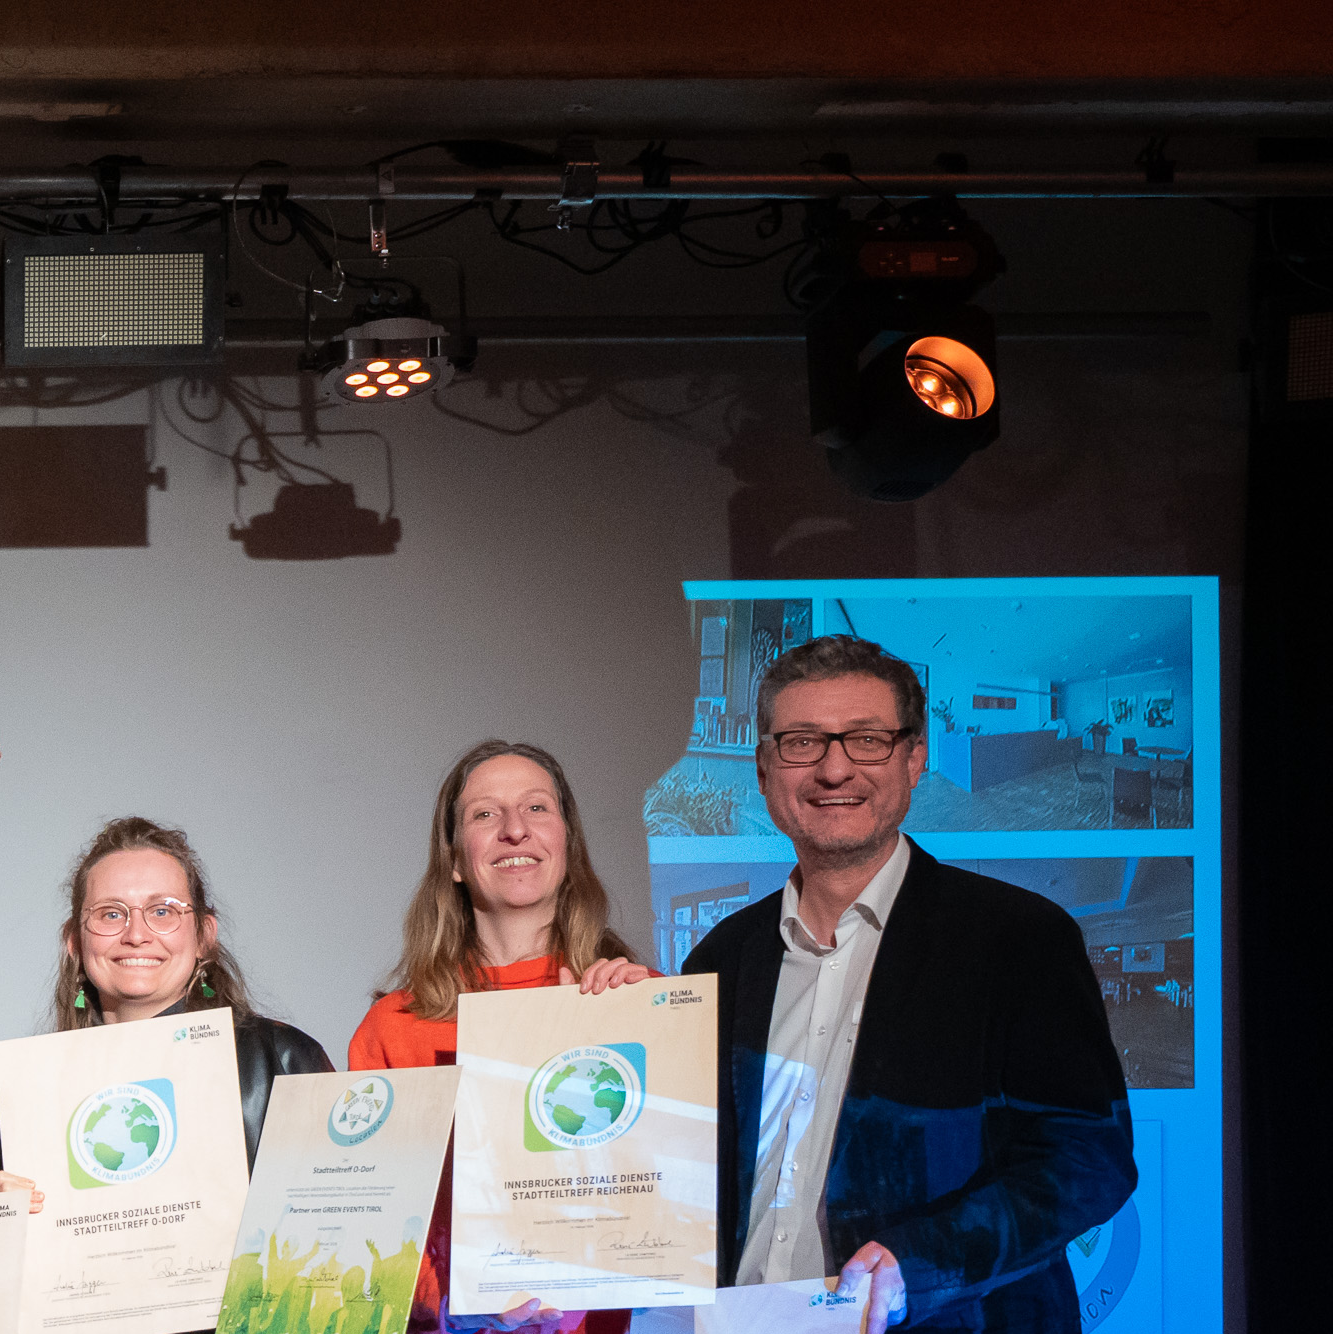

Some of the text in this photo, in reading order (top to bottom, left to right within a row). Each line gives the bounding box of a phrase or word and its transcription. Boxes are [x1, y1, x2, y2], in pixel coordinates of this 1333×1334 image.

[670, 996, 702, 1004] BÜNDNIS
[190, 1024, 211, 1032] KLIMA
[190, 1030, 220, 1039] BÜNDNIS
[561, 1049, 608, 1062] WIR SIND
[96, 1087, 140, 1101] WIR SIND
[548, 1123, 624, 1146] KLIMABÜNDNIS
[92, 1157, 161, 1182] KLIMABÜNDNIS
[313, 1166, 353, 1174] Stadtteiltreff
[505, 1172, 662, 1189] INNSBRUCKER SOZIALE DIENSTE
[513, 1185, 653, 1200] STADTTEILTREFF REICHENAU
[57, 1201, 201, 1227] INNSBRUCKER SOZIALE DIENSTE
[74, 1214, 185, 1236] STADTTEILTREFF O-DORF
[825, 1296, 856, 1305] BÜNDNIS
